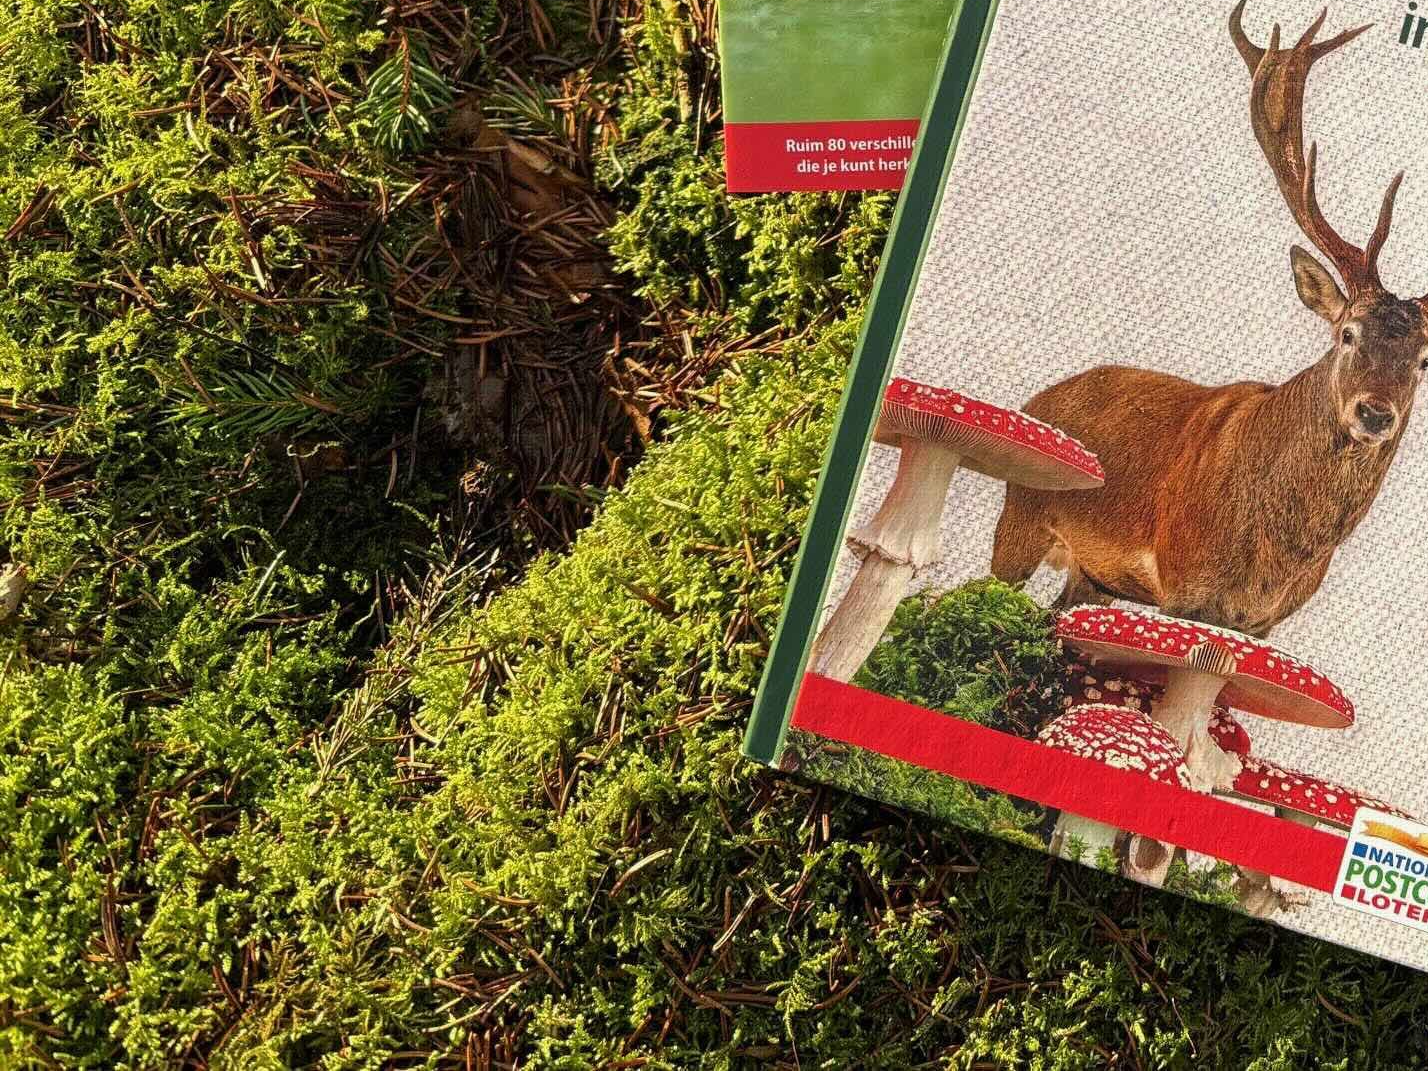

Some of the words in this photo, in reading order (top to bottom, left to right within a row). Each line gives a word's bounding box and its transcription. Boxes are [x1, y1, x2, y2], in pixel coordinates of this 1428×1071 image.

[786, 139, 824, 152] Ruim
[828, 139, 845, 151] 80
[797, 160, 819, 173] die
[822, 159, 837, 175] je
[841, 159, 875, 172] kunt
